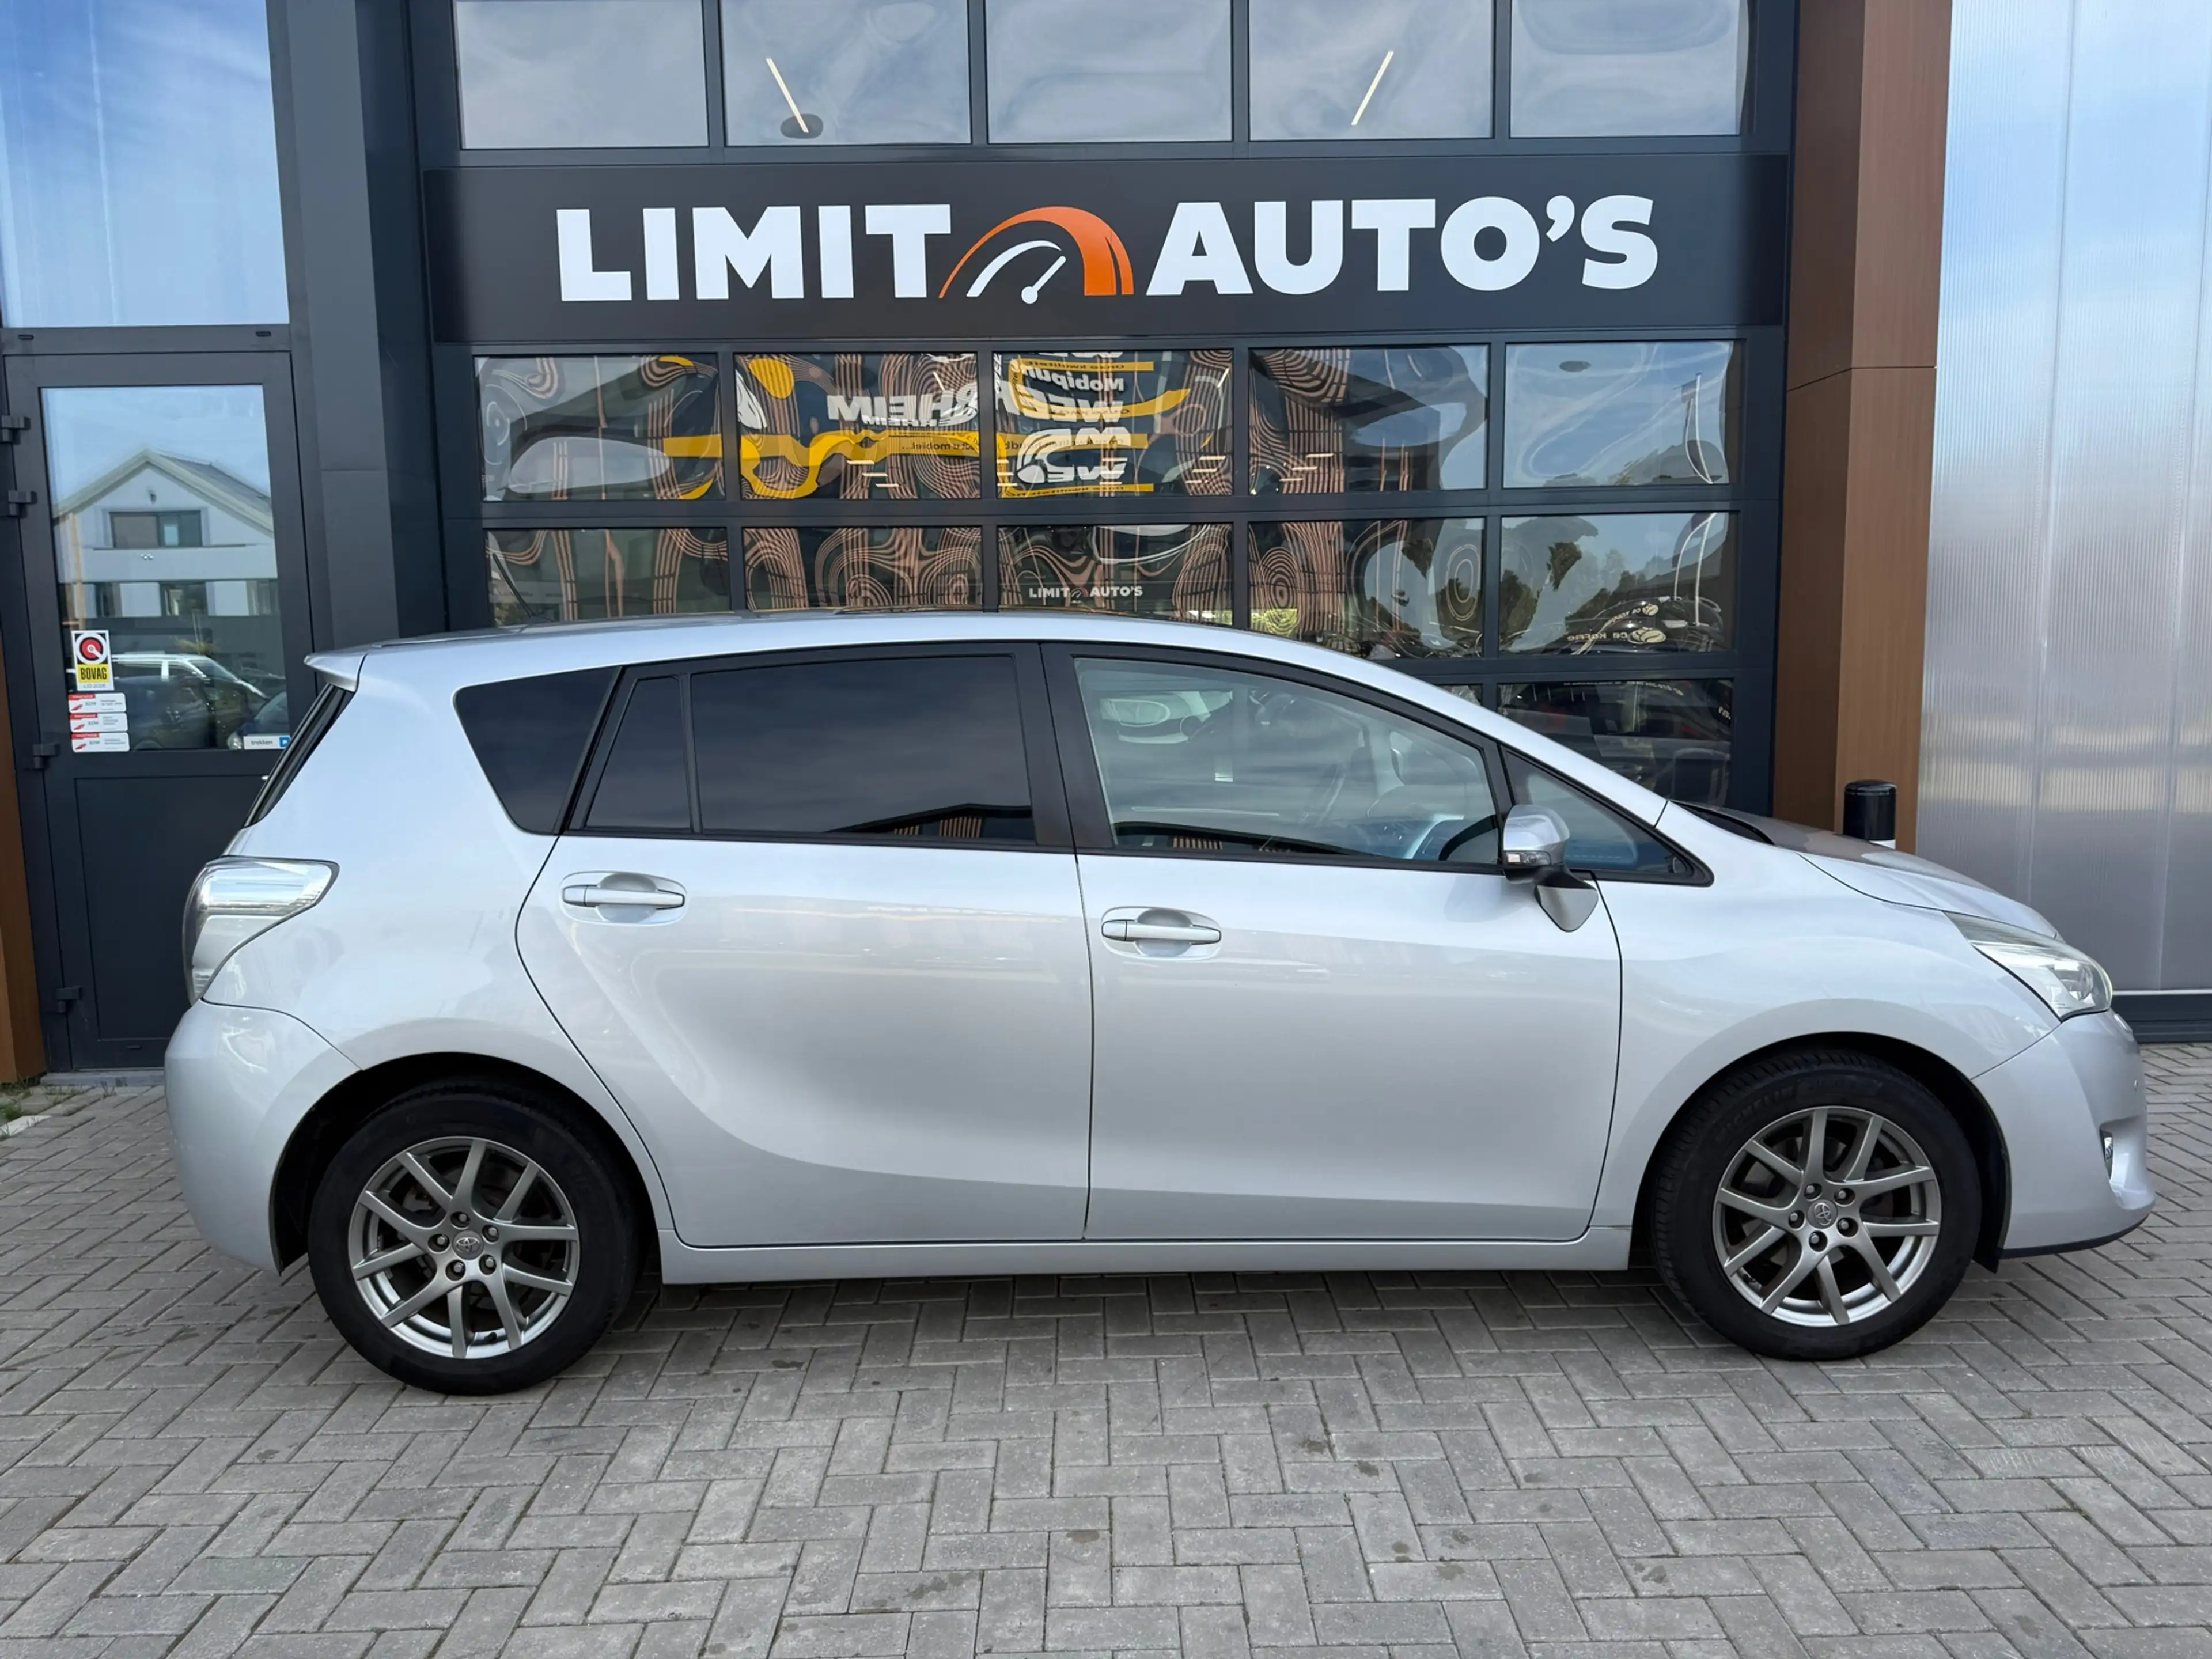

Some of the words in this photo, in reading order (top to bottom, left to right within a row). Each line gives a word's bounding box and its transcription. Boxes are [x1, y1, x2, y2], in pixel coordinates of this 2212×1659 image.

[557, 204, 950, 301] LIMIT
[1146, 195, 1657, 295] AUTO'S
[1029, 588, 1070, 598] LIMIT
[1089, 586, 1143, 597] AUTO'S
[80, 667, 107, 680] BOVAG
